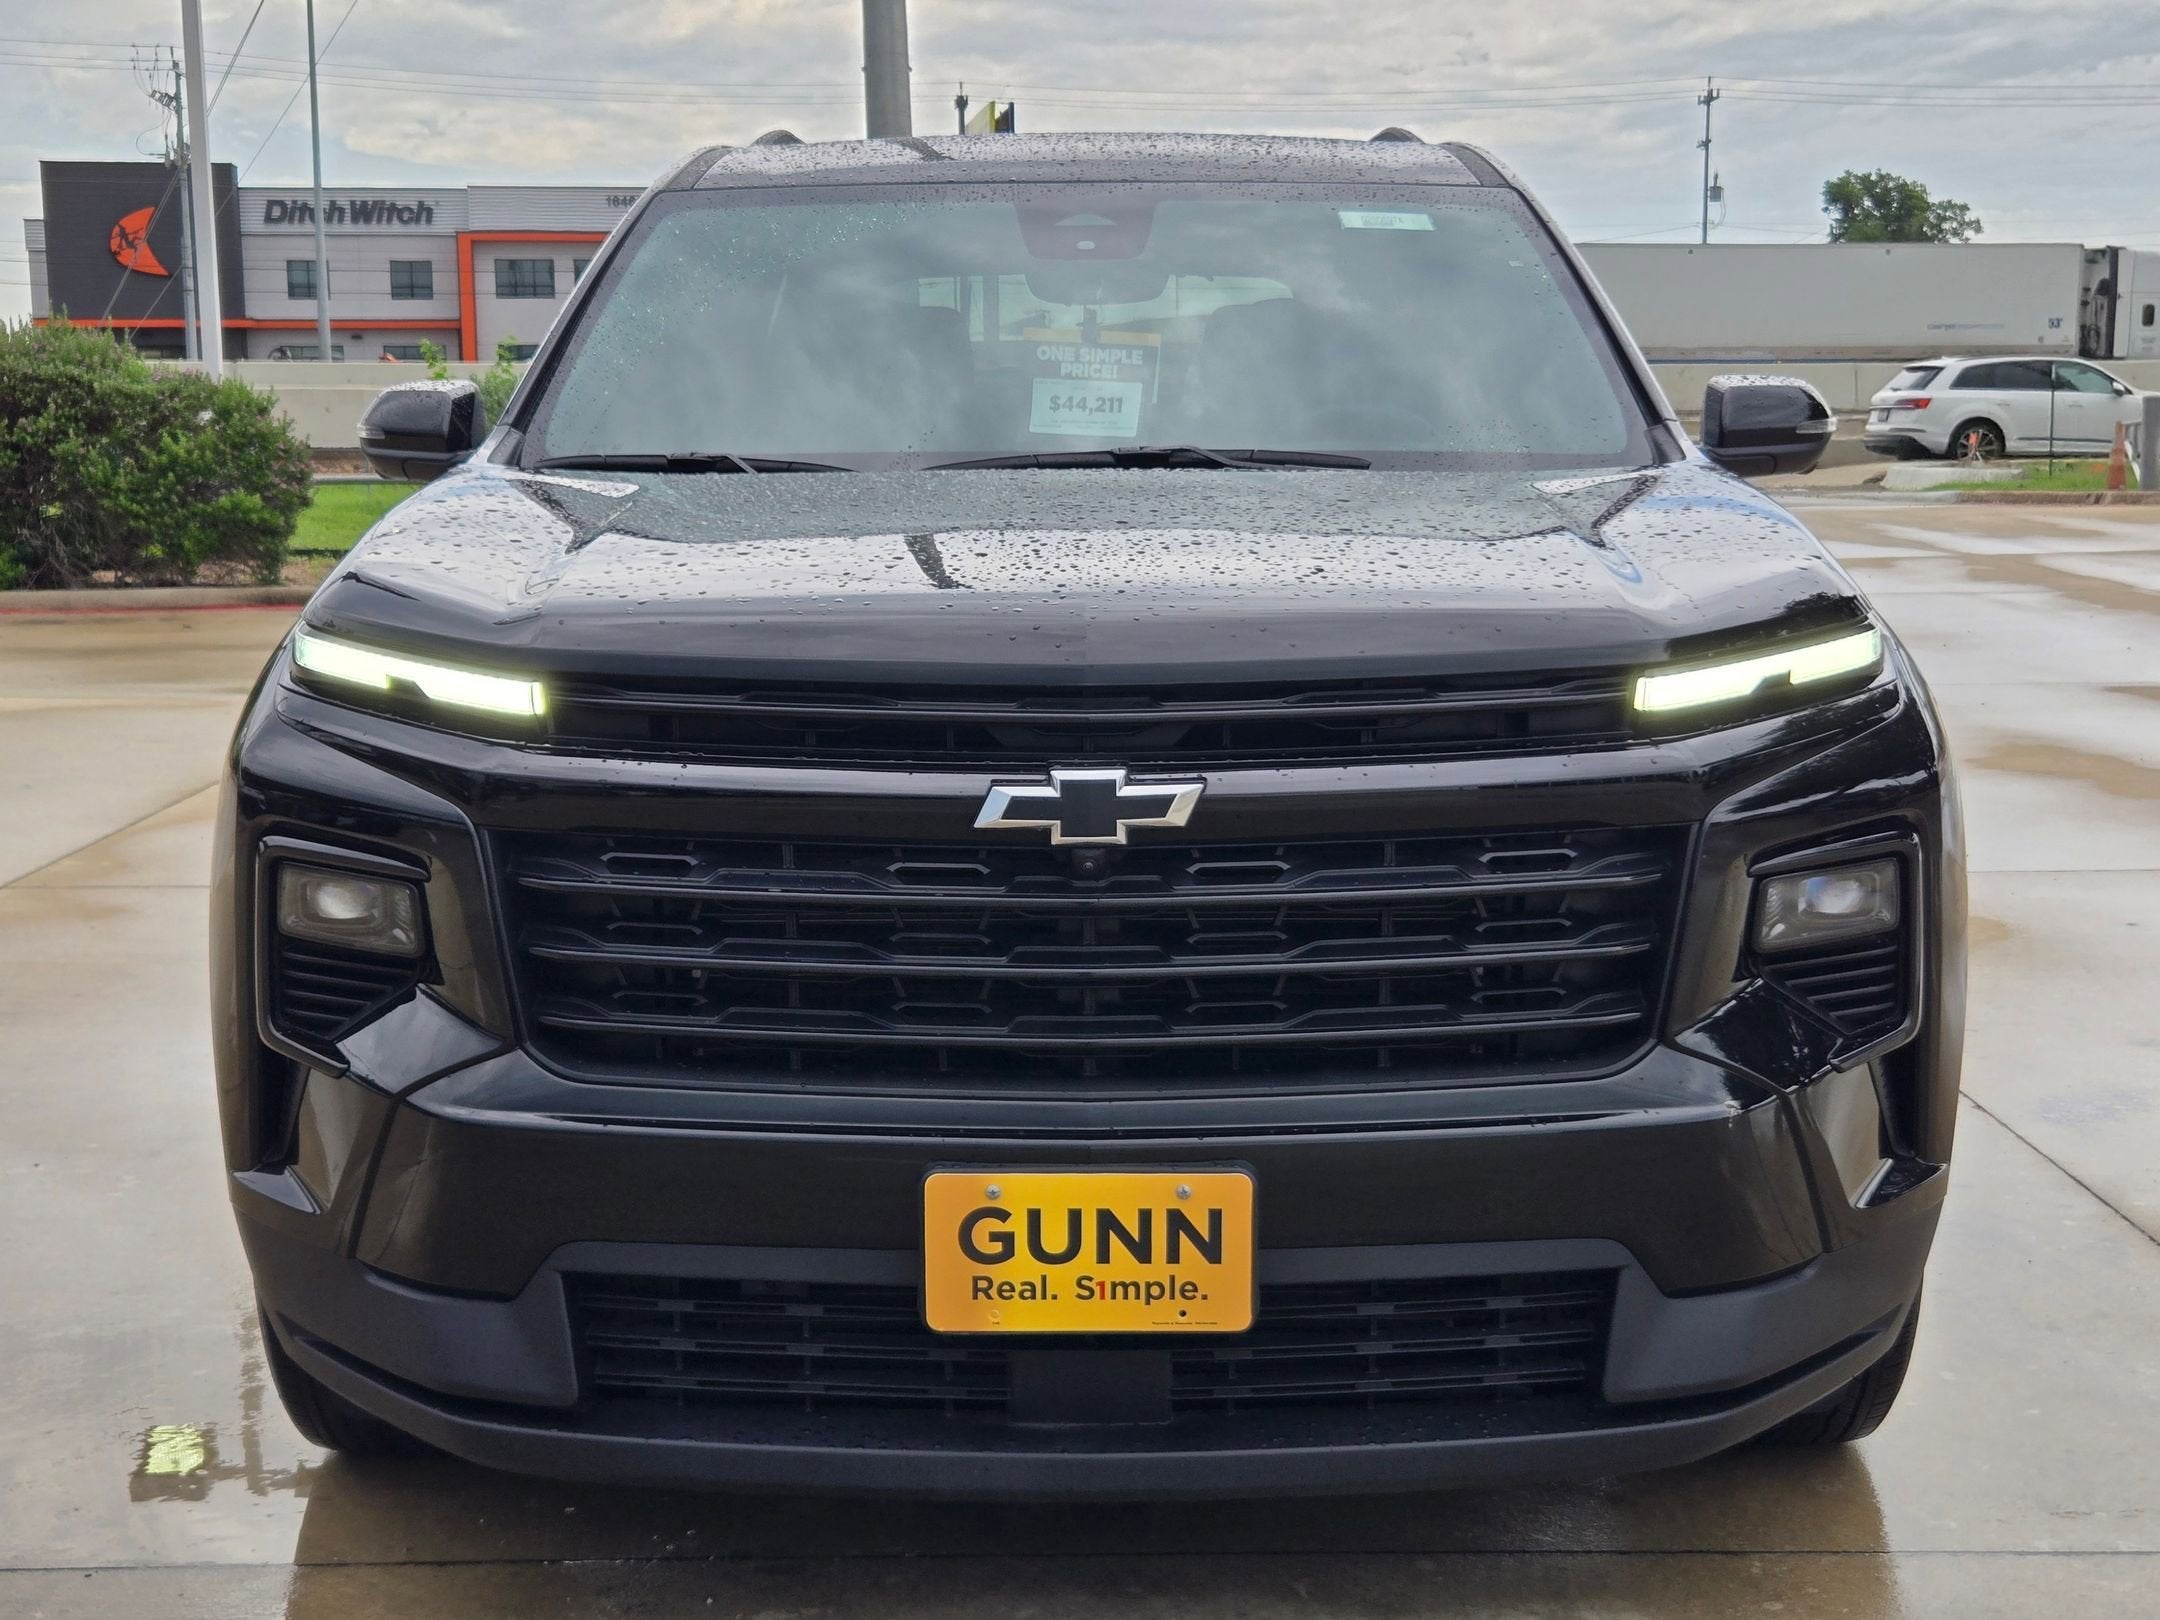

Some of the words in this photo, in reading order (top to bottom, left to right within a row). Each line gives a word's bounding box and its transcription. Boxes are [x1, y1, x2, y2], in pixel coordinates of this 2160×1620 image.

[350, 200, 434, 225] Witch
[1037, 345, 1076, 362] ONE
[1079, 347, 1143, 365] SIMPLE
[1060, 362, 1118, 379] PRICE!
[1049, 394, 1124, 416] $44,211
[958, 1206, 1223, 1266] GUNN
[971, 1274, 1058, 1301] Real.
[1074, 1274, 1208, 1306] S1mple.
